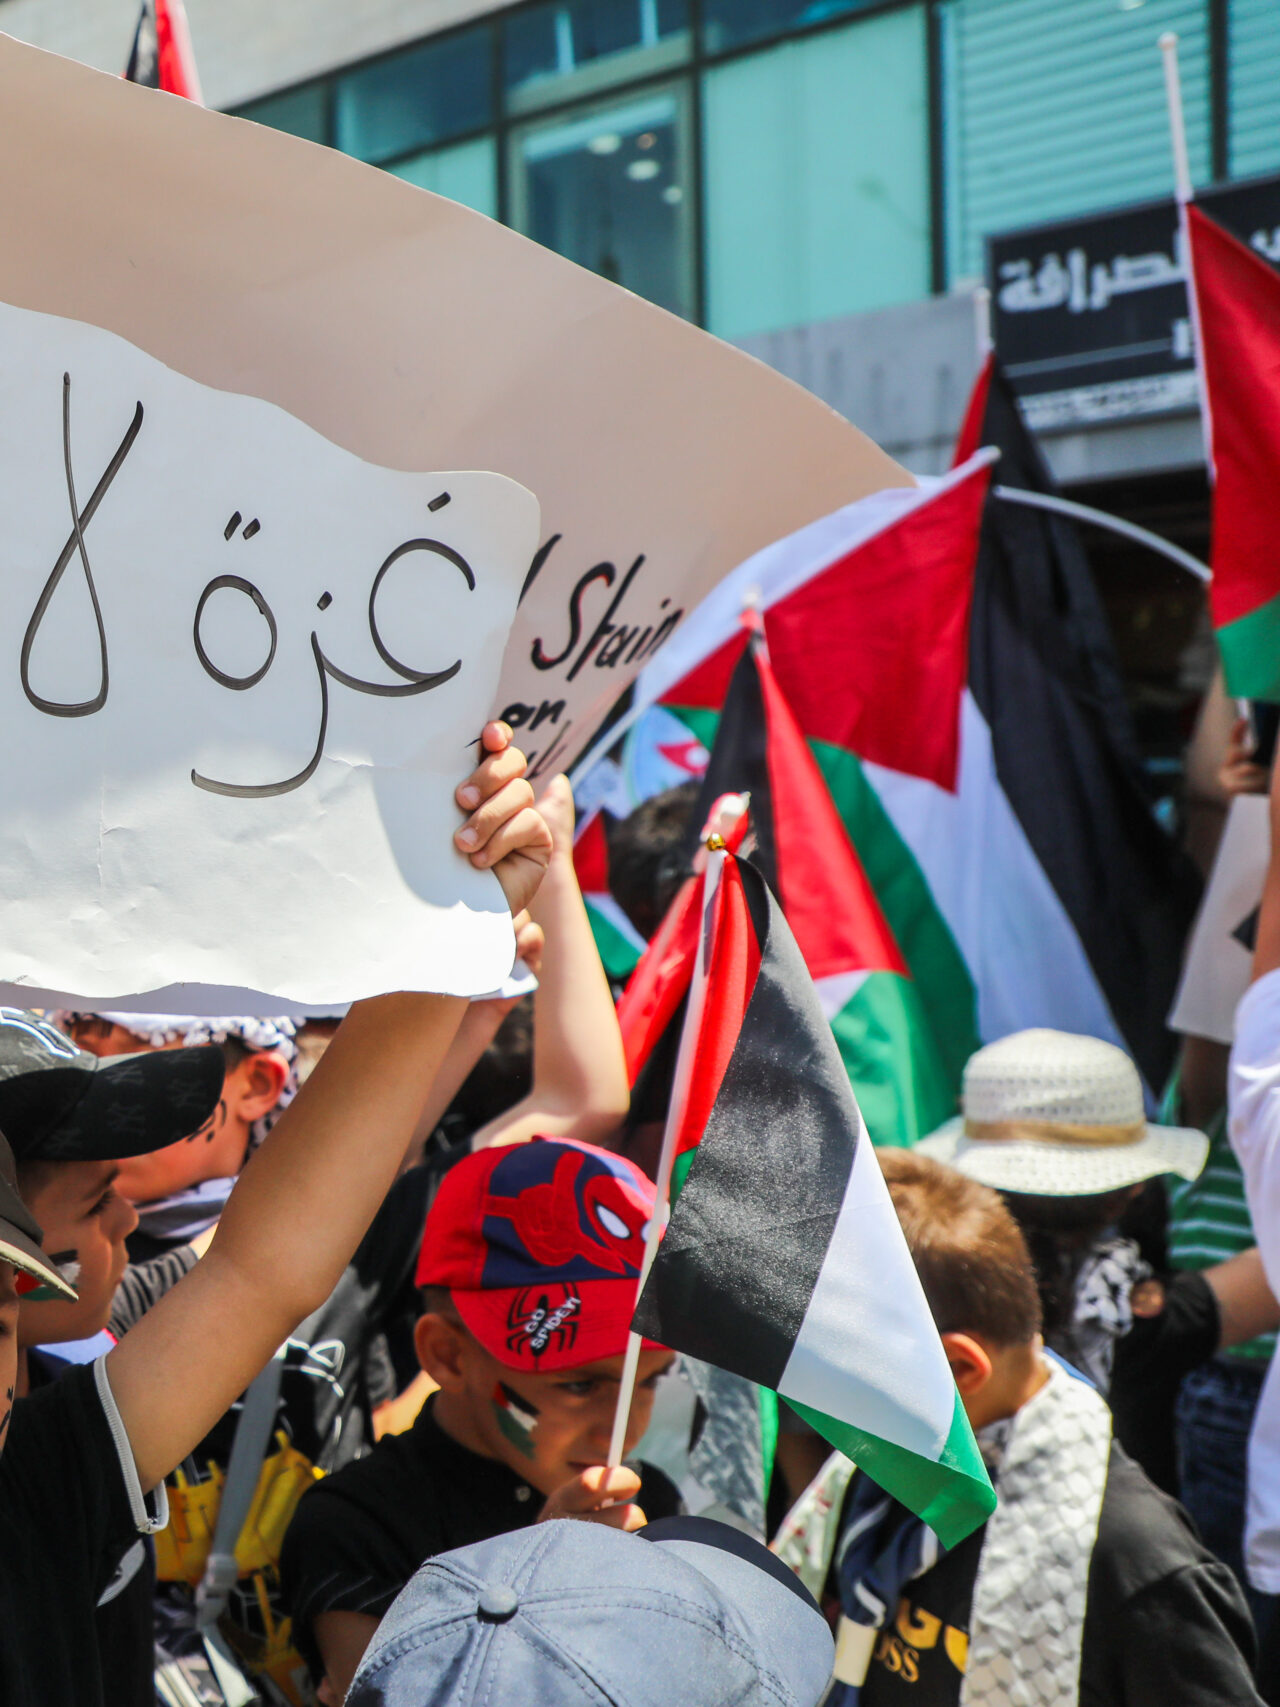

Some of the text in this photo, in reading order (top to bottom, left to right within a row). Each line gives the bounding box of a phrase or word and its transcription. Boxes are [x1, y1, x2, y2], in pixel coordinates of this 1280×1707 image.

[21, 371, 144, 718] لا
[191, 491, 476, 799] غزة
[524, 1308, 546, 1334] GO
